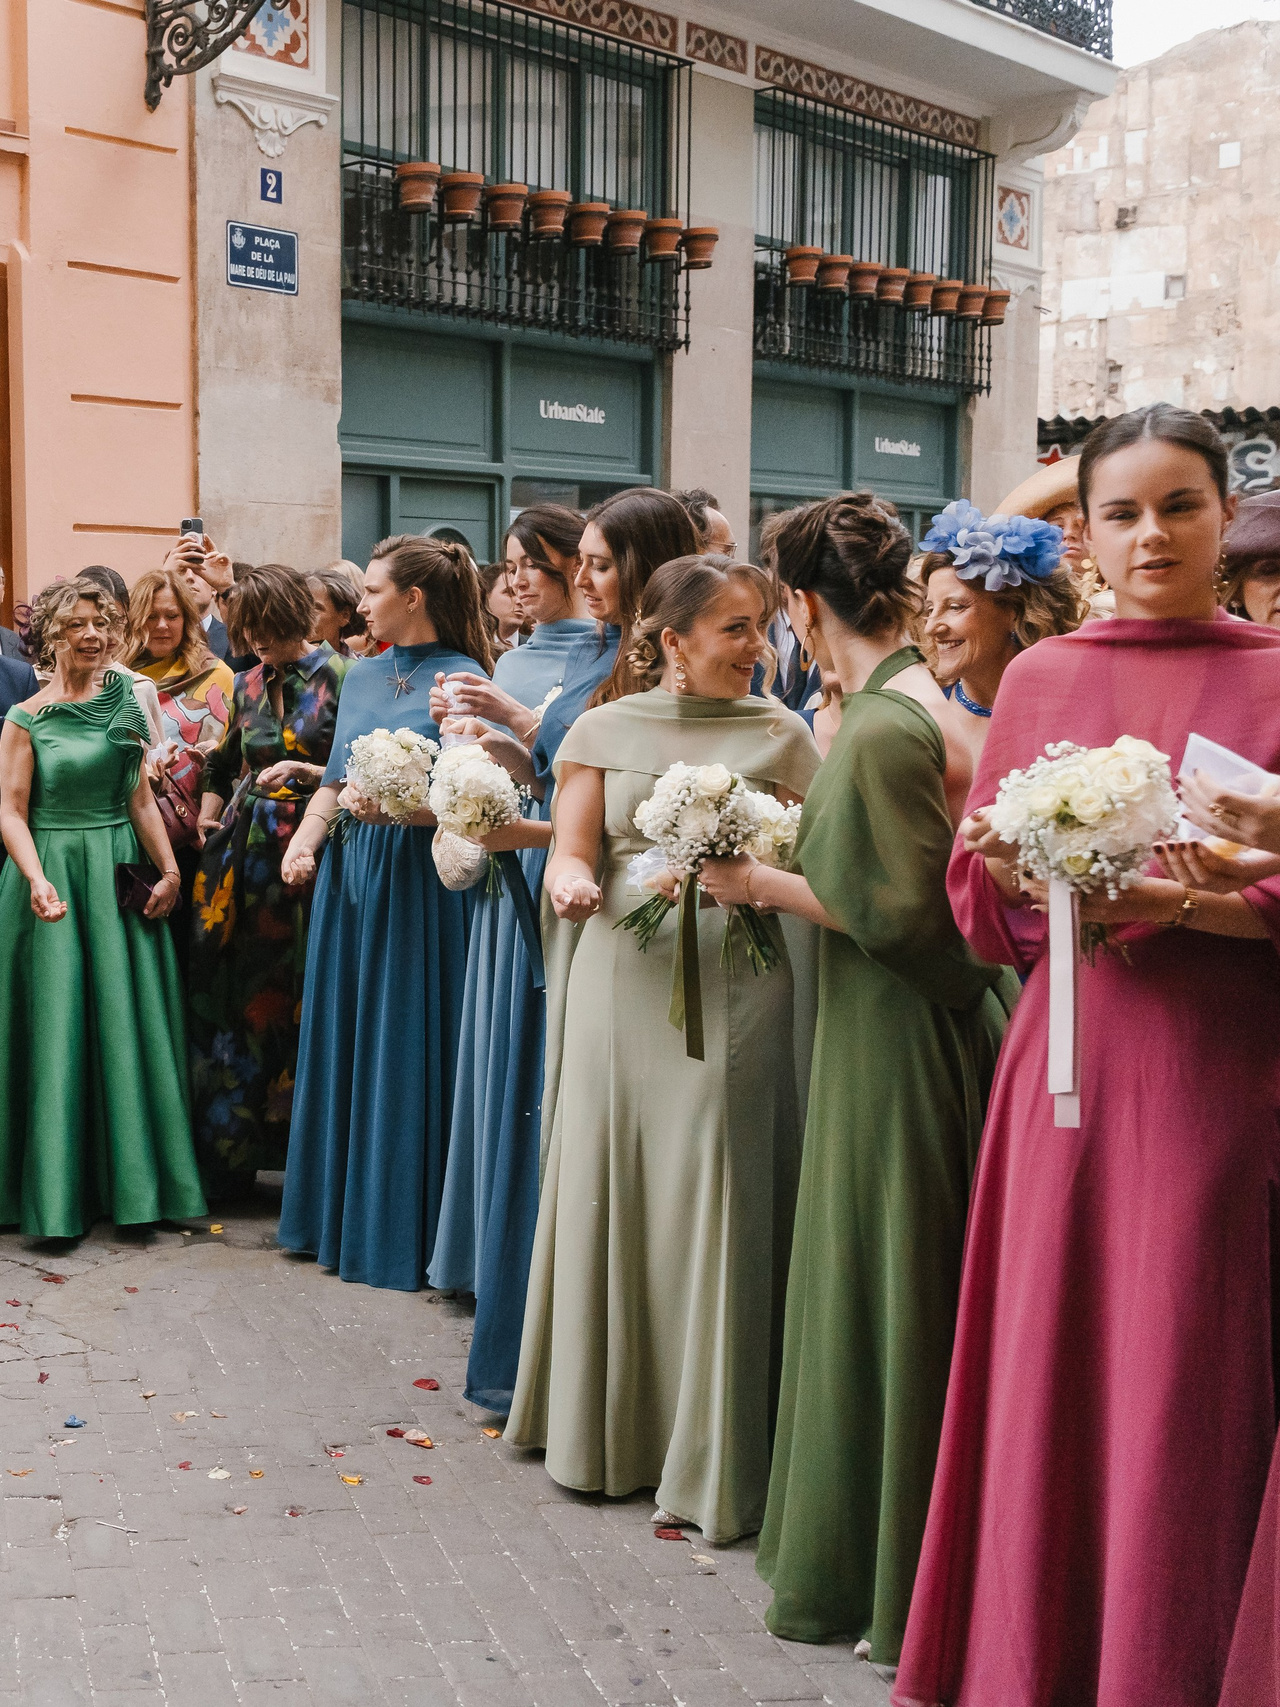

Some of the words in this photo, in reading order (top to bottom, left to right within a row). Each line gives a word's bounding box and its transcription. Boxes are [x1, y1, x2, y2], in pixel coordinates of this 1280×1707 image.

[266, 173, 276, 198] 2
[255, 236, 280, 249] PLAÇA
[251, 251, 262, 262] DE
[263, 253, 274, 263] LA
[230, 263, 246, 277] MARE
[247, 267, 254, 277] DE
[255, 265, 267, 280] DÉU
[268, 270, 275, 281] DE
[276, 271, 284, 283] LA
[540, 399, 605, 424] UrbanState
[874, 436, 921, 457] UrbanState
